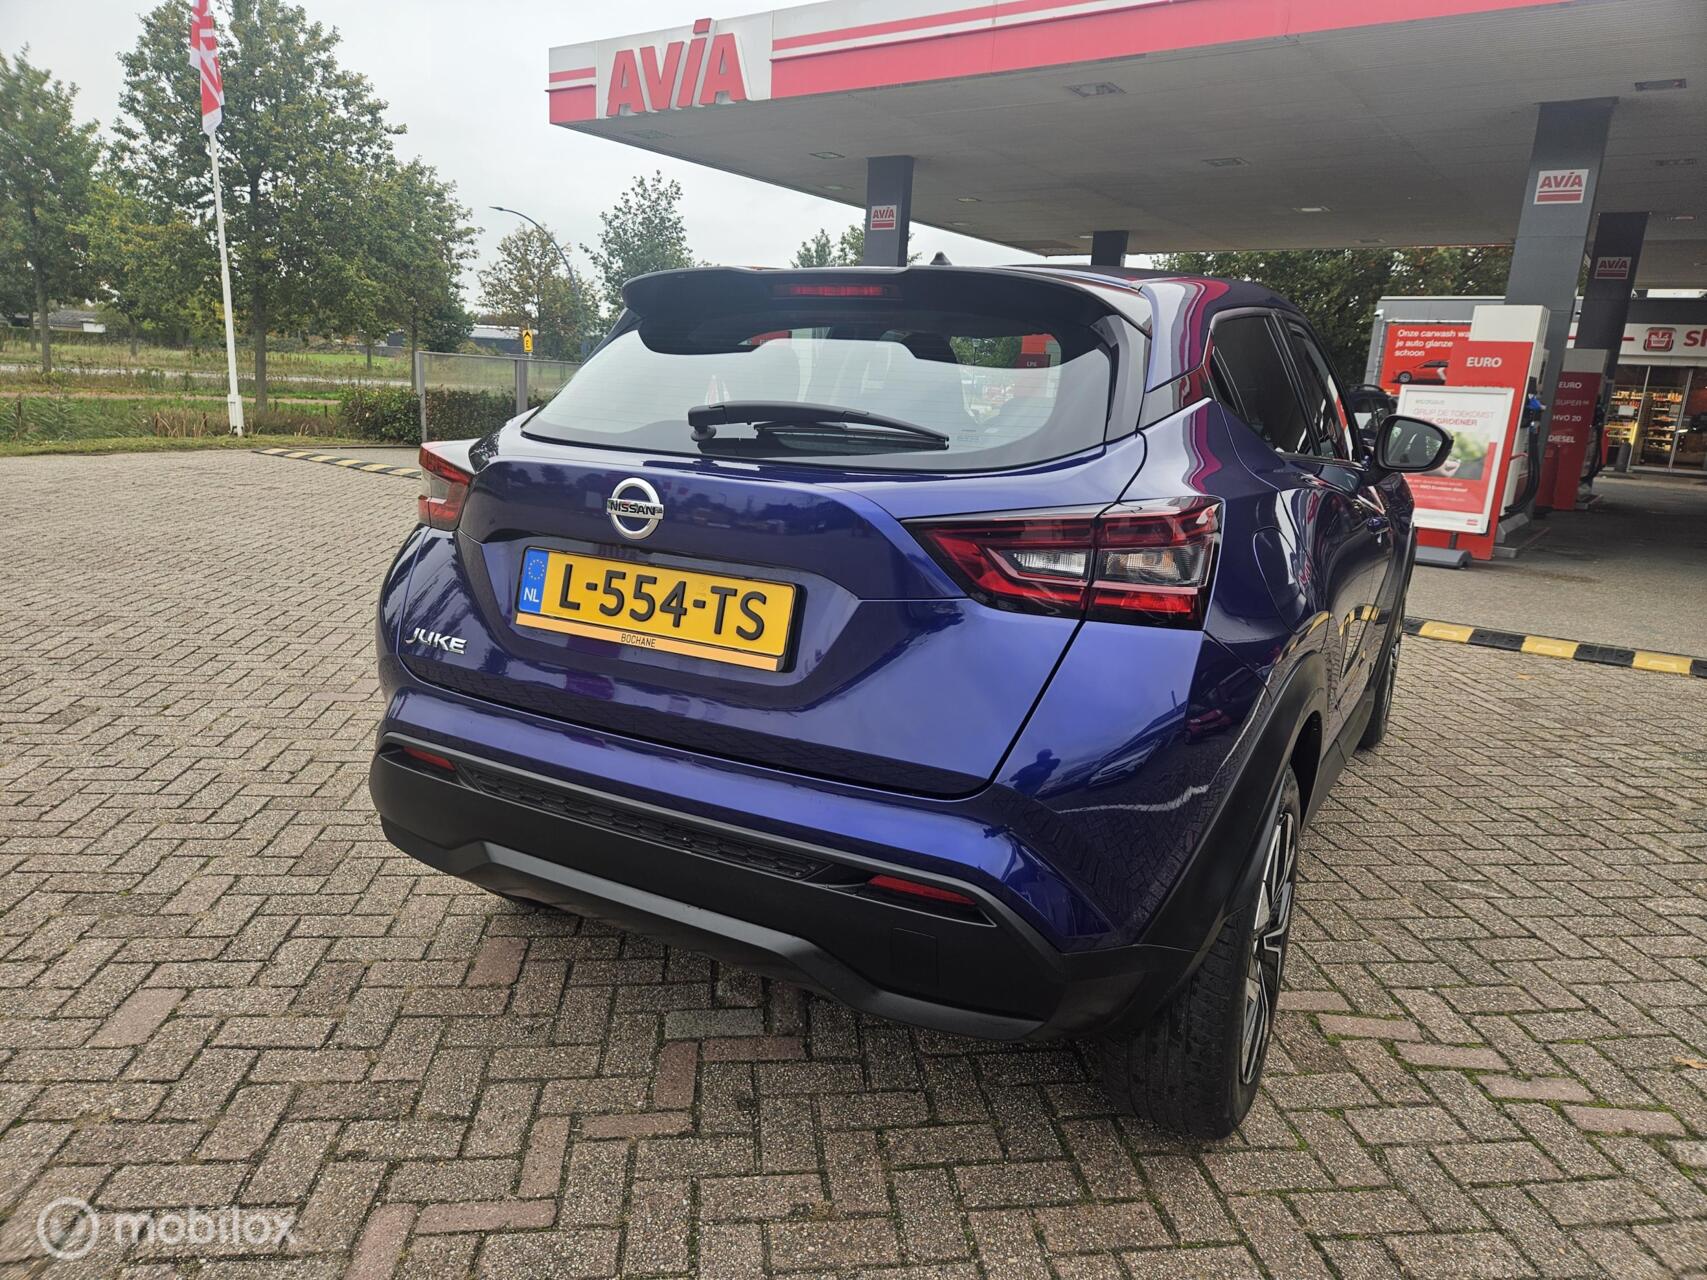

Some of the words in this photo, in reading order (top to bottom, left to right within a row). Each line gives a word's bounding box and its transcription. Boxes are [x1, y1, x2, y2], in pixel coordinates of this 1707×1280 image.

[1397, 329, 1419, 337] Onze
[1420, 330, 1456, 338] carwash
[1395, 339, 1404, 348] je
[1394, 349, 1425, 357] schoon
[1466, 357, 1502, 368] EURO
[1558, 381, 1582, 389] EURO
[1547, 435, 1576, 443] DIESEL
[609, 499, 656, 516] NISSAN
[524, 587, 540, 602] NL
[559, 563, 767, 641] L-554-TS
[405, 627, 467, 655] JUKE
[620, 632, 657, 648] BOCHANE
